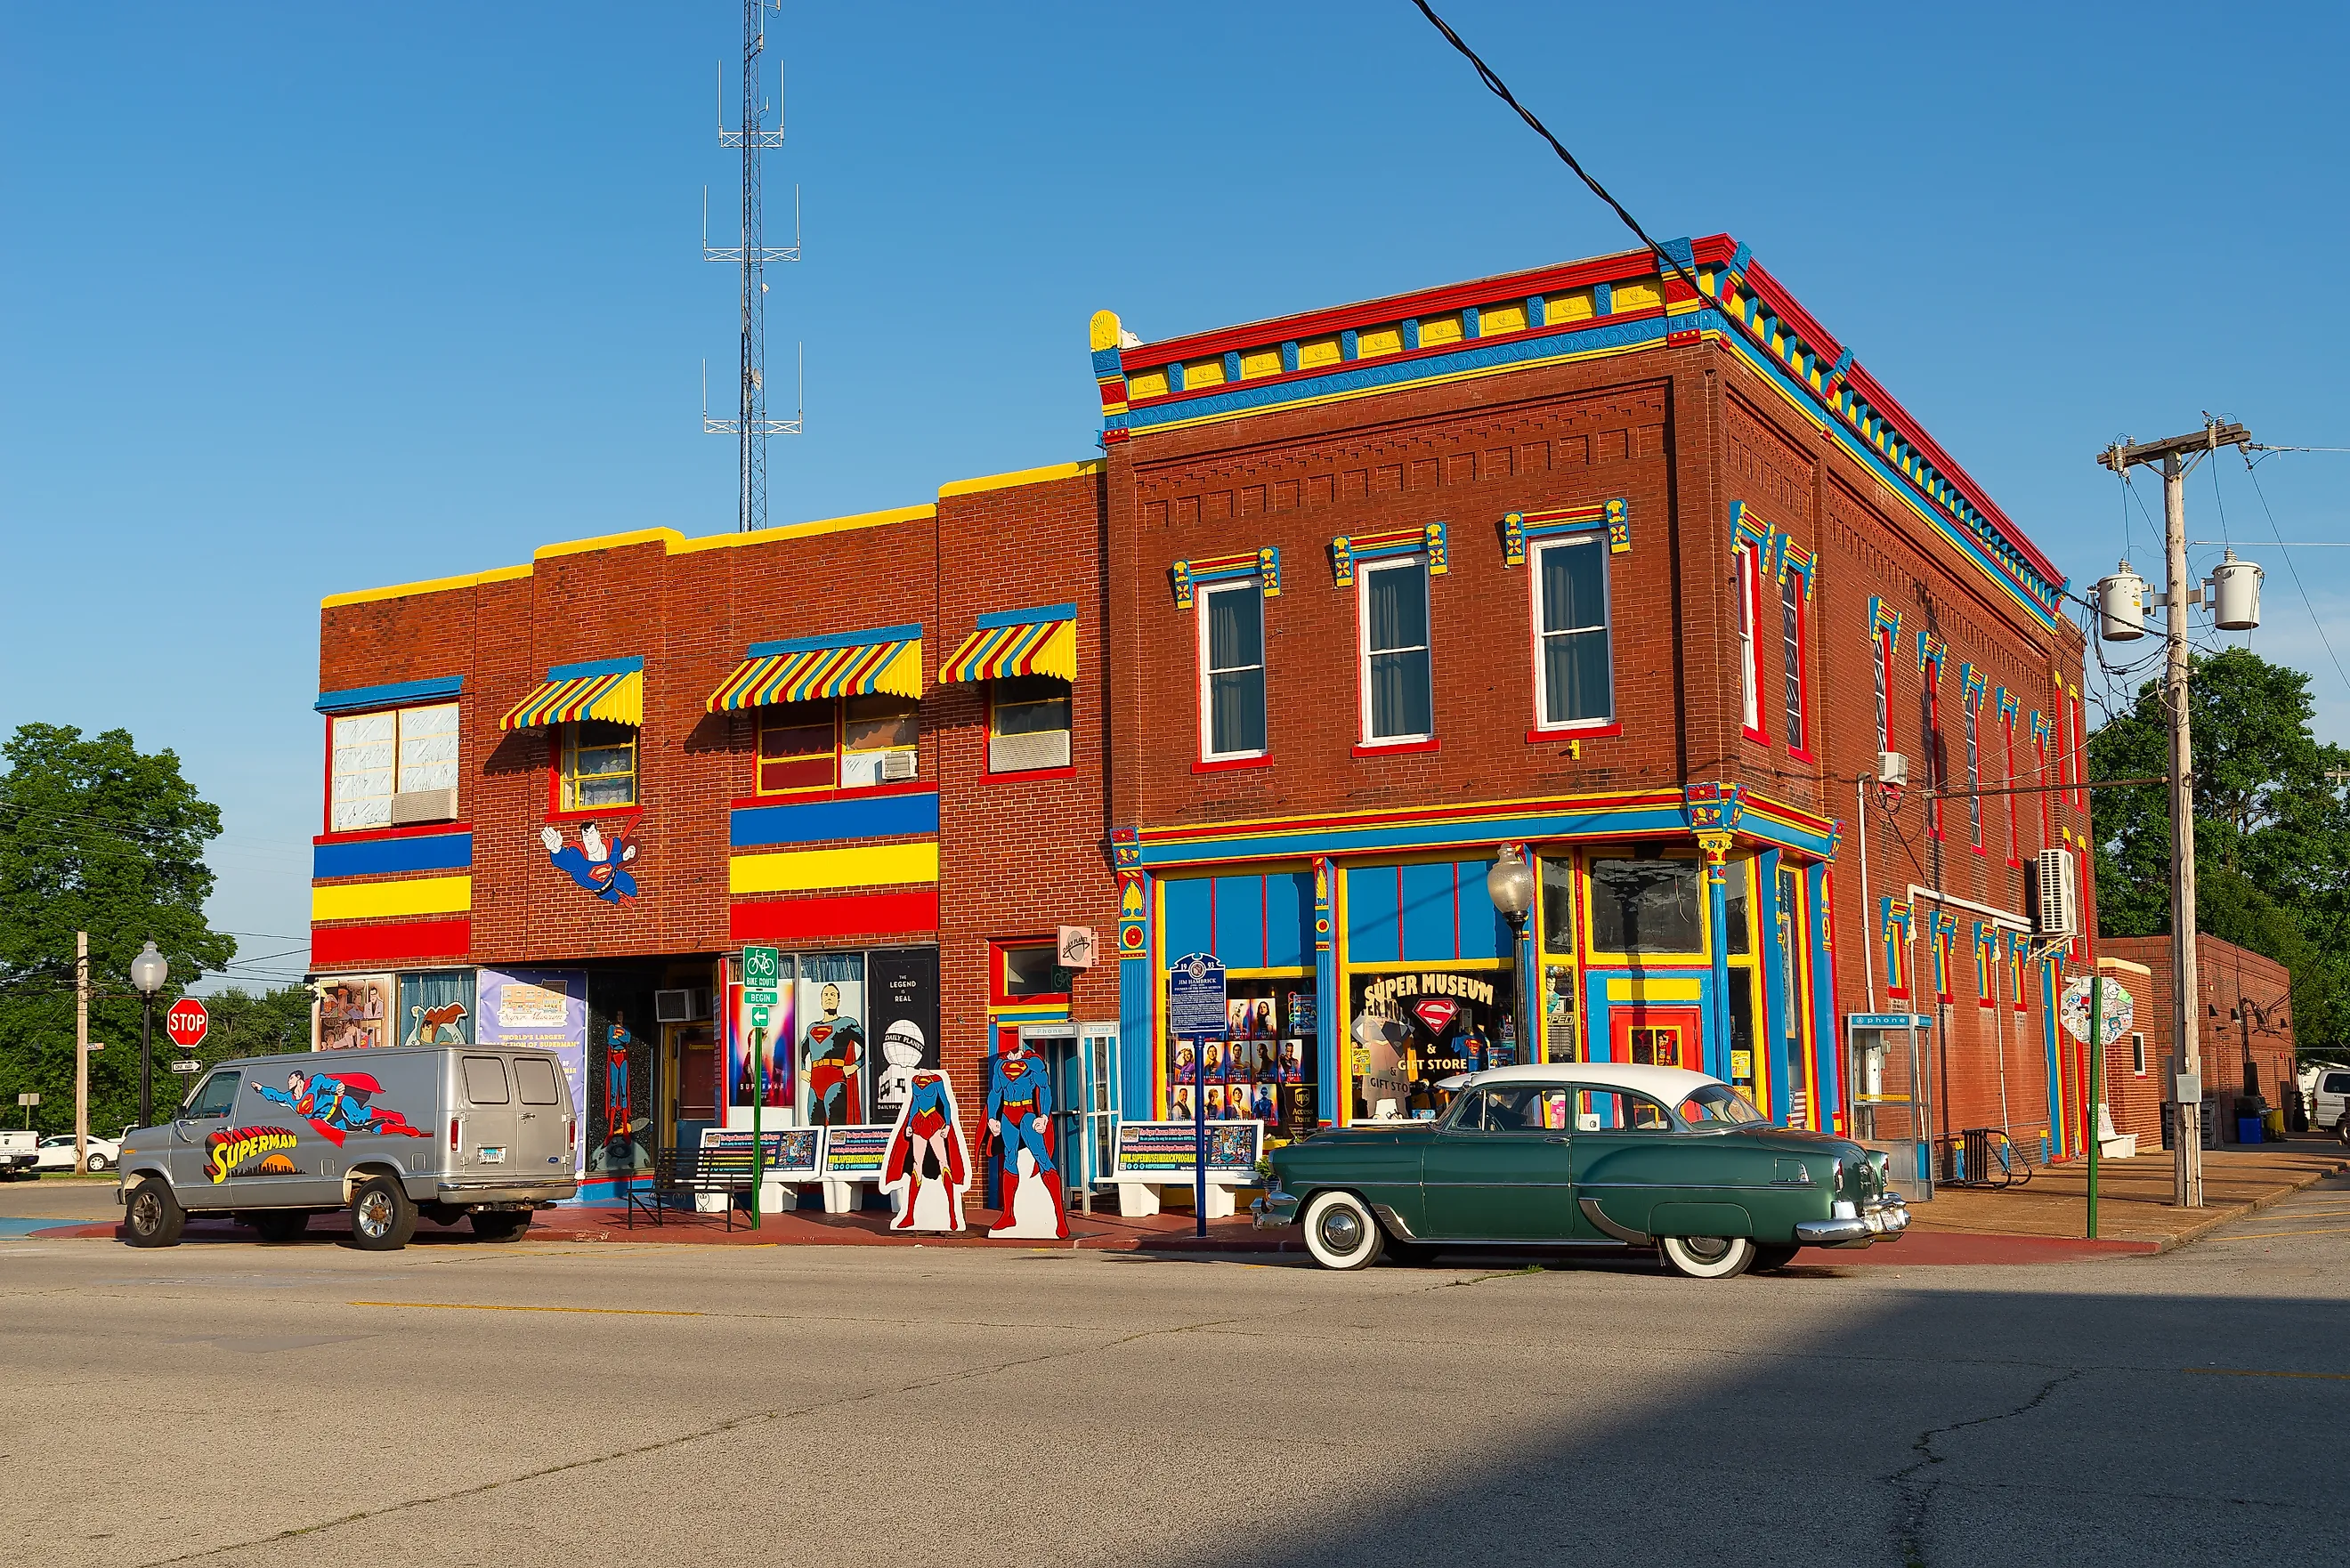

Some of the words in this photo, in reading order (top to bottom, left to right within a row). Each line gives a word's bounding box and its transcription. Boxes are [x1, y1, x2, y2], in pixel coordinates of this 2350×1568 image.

[1062, 941, 1074, 953] DAILY
[1074, 936, 1088, 945] PLANET
[746, 977, 758, 986] BIKE
[759, 977, 775, 987] ROUTE
[889, 981, 916, 989] LEGEND
[1365, 974, 1418, 1007] SUPER
[1422, 974, 1494, 1006] MUSEUM
[750, 994, 771, 1002] BEGIN
[170, 1013, 205, 1031] STOP
[884, 1034, 902, 1042] DAILY
[903, 1036, 925, 1052] PLANET
[1426, 1044, 1437, 1054] &
[1398, 1059, 1424, 1071] GIFT
[1427, 1059, 1468, 1070] STORE
[1296, 1093, 1309, 1105] ups
[1292, 1107, 1314, 1115] Access
[1294, 1115, 1311, 1123] Point
[212, 1134, 297, 1184] SUPERMAN
